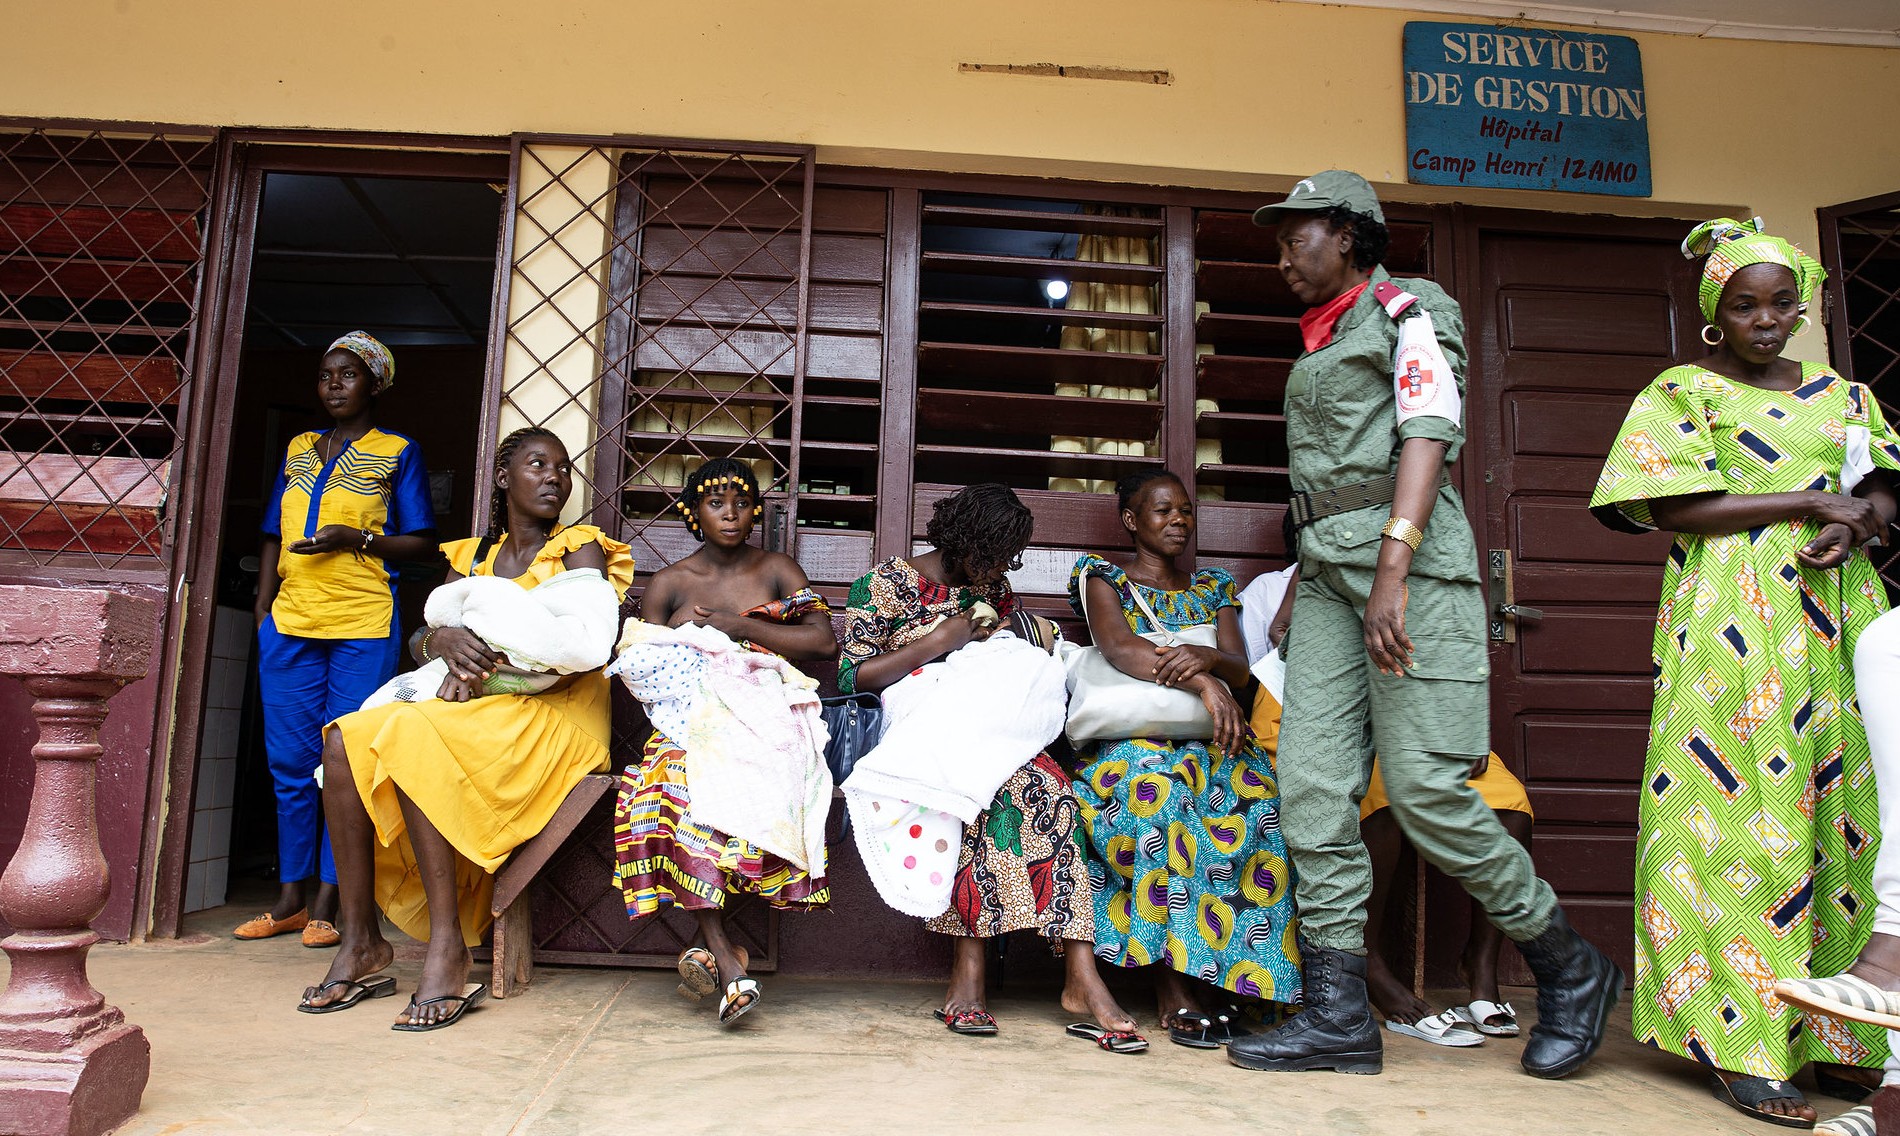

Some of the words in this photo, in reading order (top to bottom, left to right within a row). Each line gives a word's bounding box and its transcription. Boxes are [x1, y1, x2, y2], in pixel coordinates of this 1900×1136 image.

[1442, 31, 1609, 74] SERVICE
[1406, 71, 1463, 106] DE
[1474, 76, 1646, 120] GESTION
[1480, 115, 1564, 149] Hôpital
[1412, 148, 1476, 183] Camp
[1485, 151, 1548, 177] Henri
[1561, 157, 1638, 183] IZAMO
[620, 858, 653, 879] URNEE
